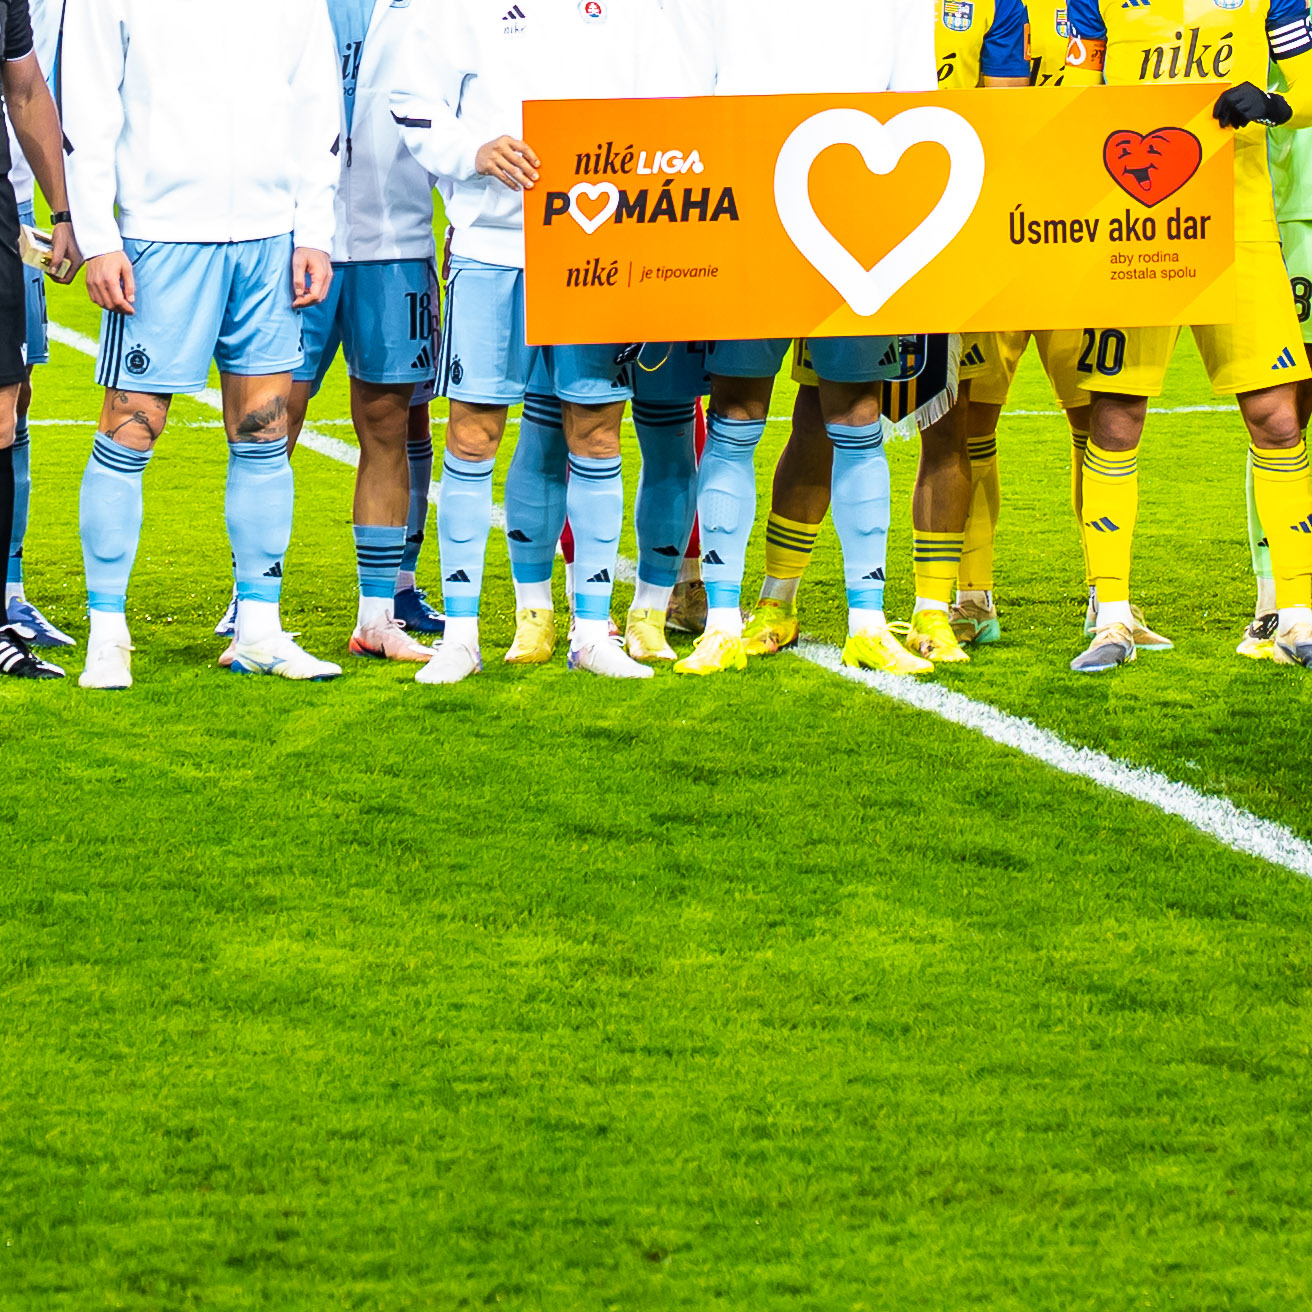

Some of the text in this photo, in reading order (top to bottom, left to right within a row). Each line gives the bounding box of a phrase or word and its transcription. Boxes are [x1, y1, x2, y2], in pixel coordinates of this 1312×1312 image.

[1138, 26, 1234, 81] niké
[574, 141, 705, 175] niké LIGA
[1009, 203, 1212, 245] Úsmev ako dar
[566, 257, 619, 288] niké
[639, 265, 719, 283] je tipovanie
[1109, 251, 1179, 267] aby rodina
[1109, 267, 1197, 281] zostala spolu
[404, 291, 433, 341] 18
[1076, 327, 1127, 376] 20
